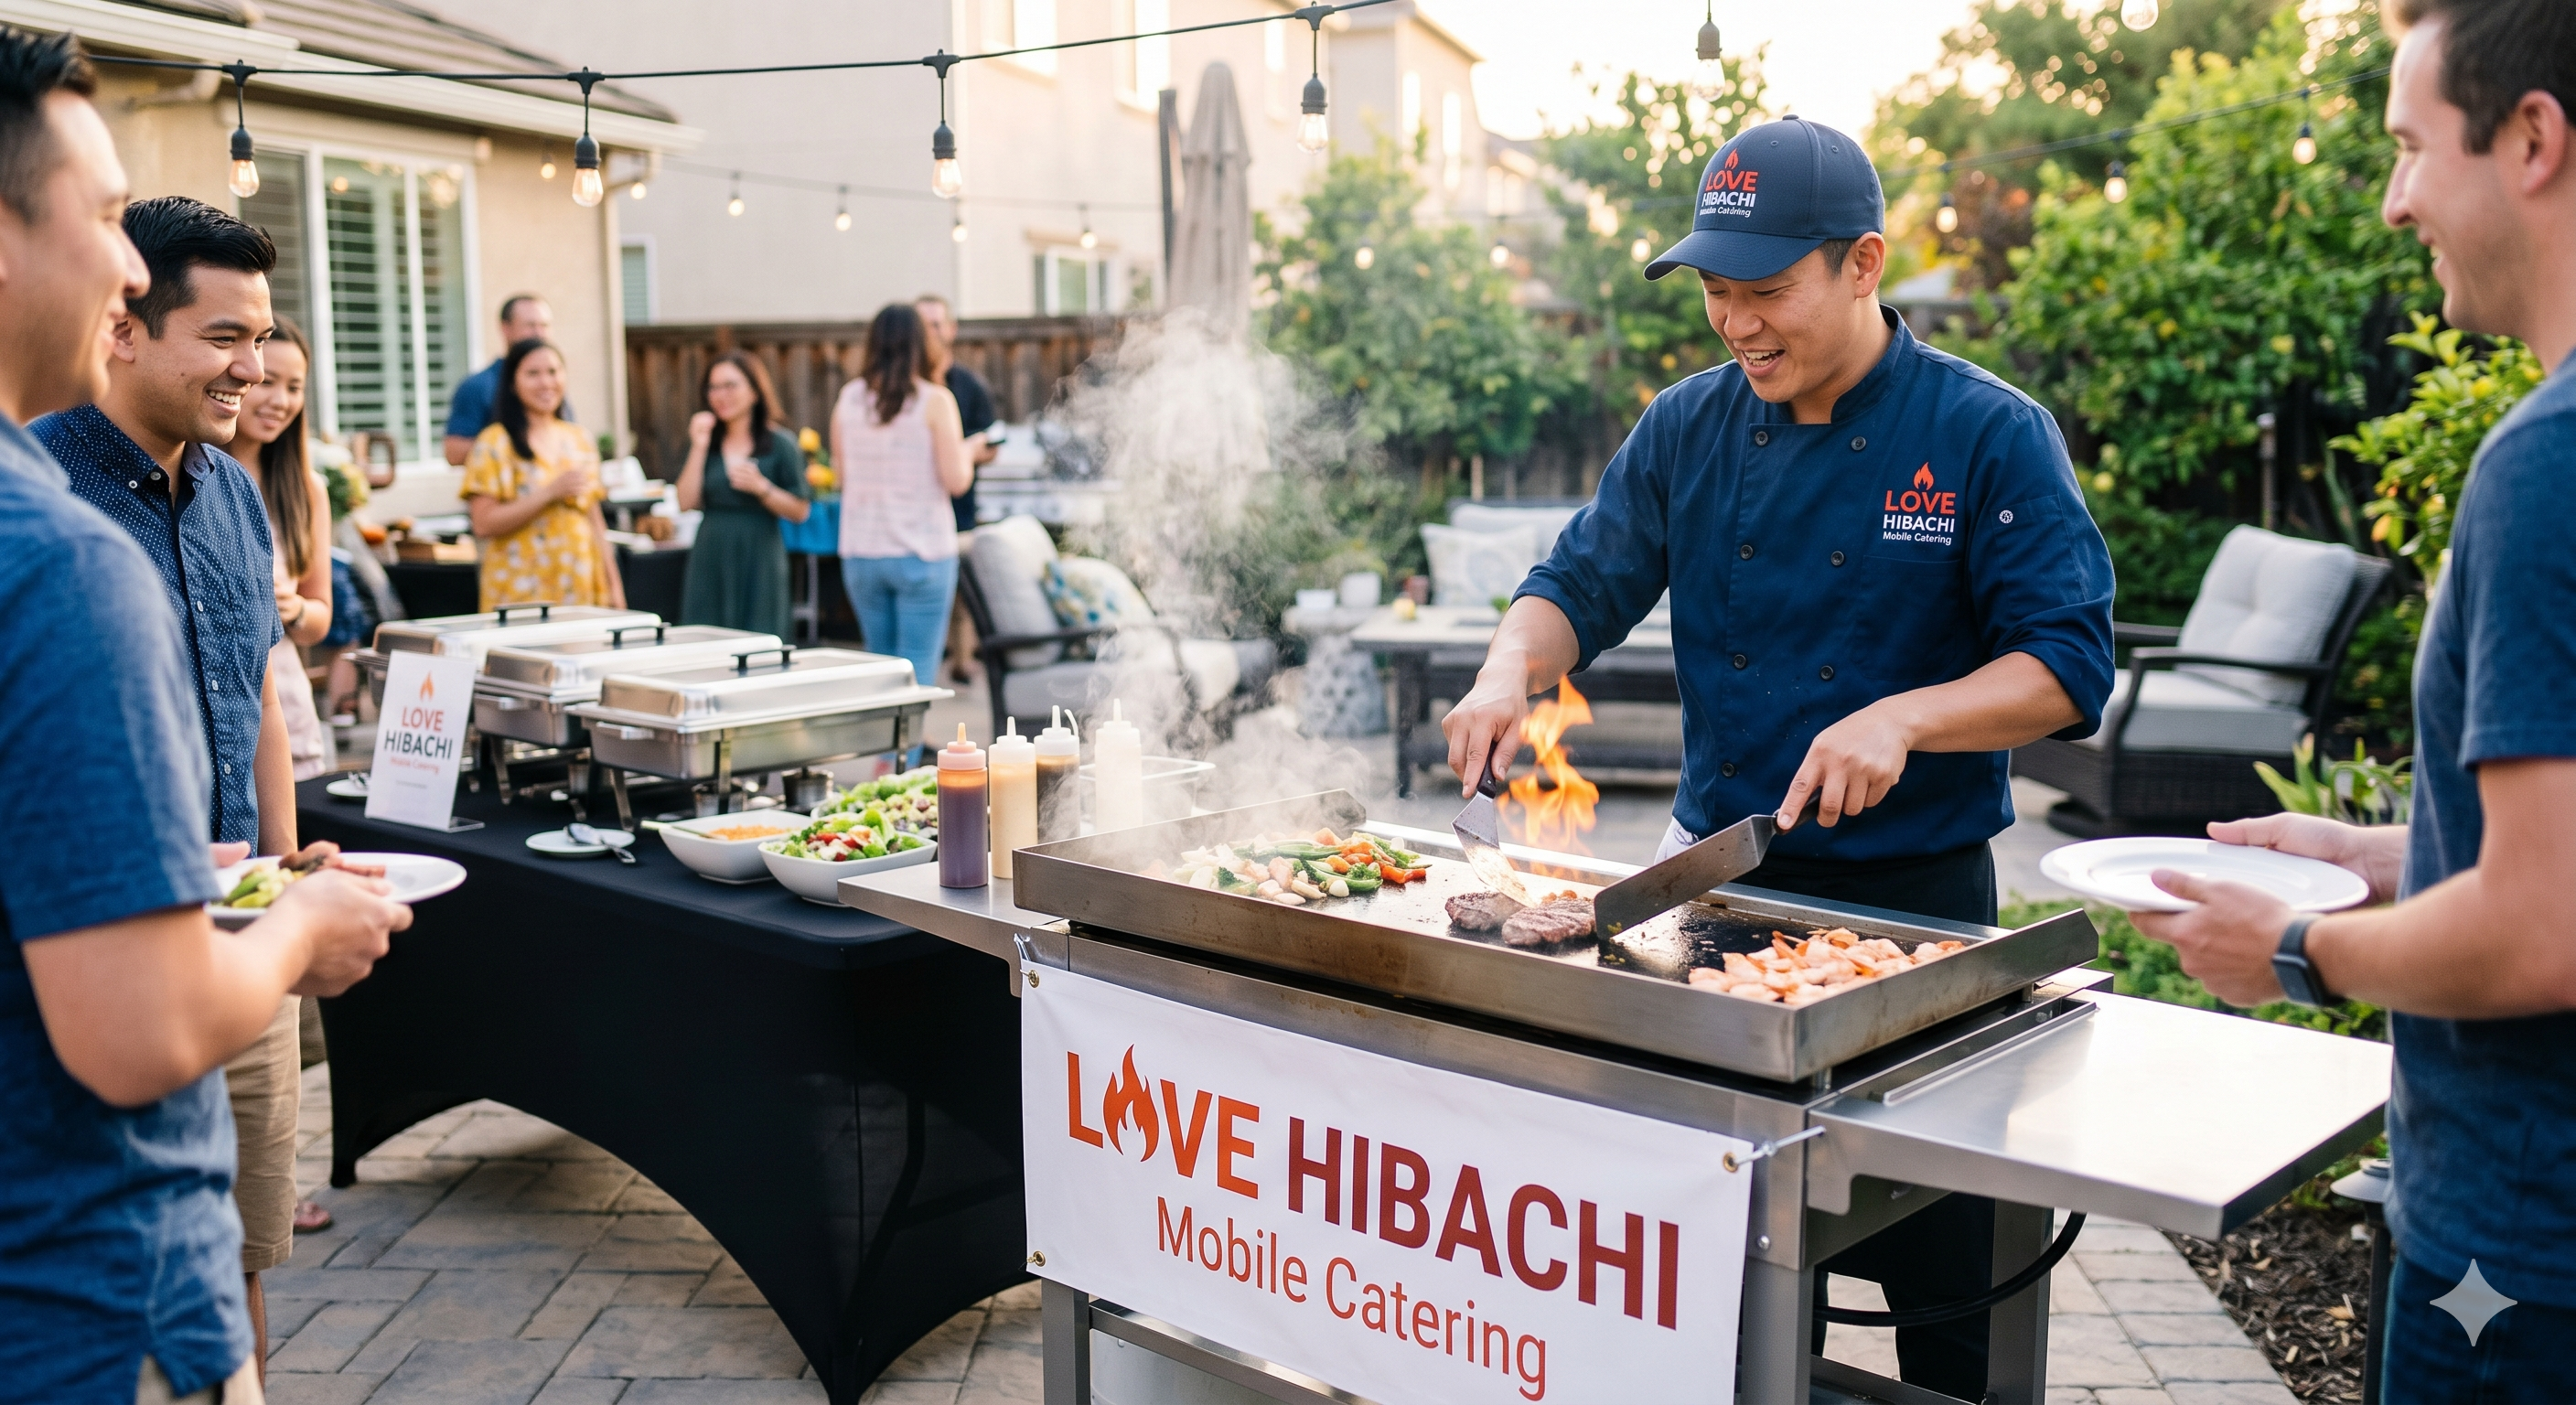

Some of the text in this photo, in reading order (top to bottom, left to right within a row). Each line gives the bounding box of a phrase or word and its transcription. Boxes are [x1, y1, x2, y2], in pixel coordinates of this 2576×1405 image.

[1705, 170, 1758, 192] LOVE
[1701, 191, 1756, 208] HIBACHI
[1884, 489, 1957, 515] LOVE
[1883, 514, 1955, 533] HIBACHI
[1883, 531, 1952, 546] Mobile Catering
[402, 706, 445, 733] LOVE
[383, 730, 453, 760] HIBACHI
[1287, 1116, 1680, 1331] HIBACHI
[1156, 1196, 1548, 1402] Mobile Catering
